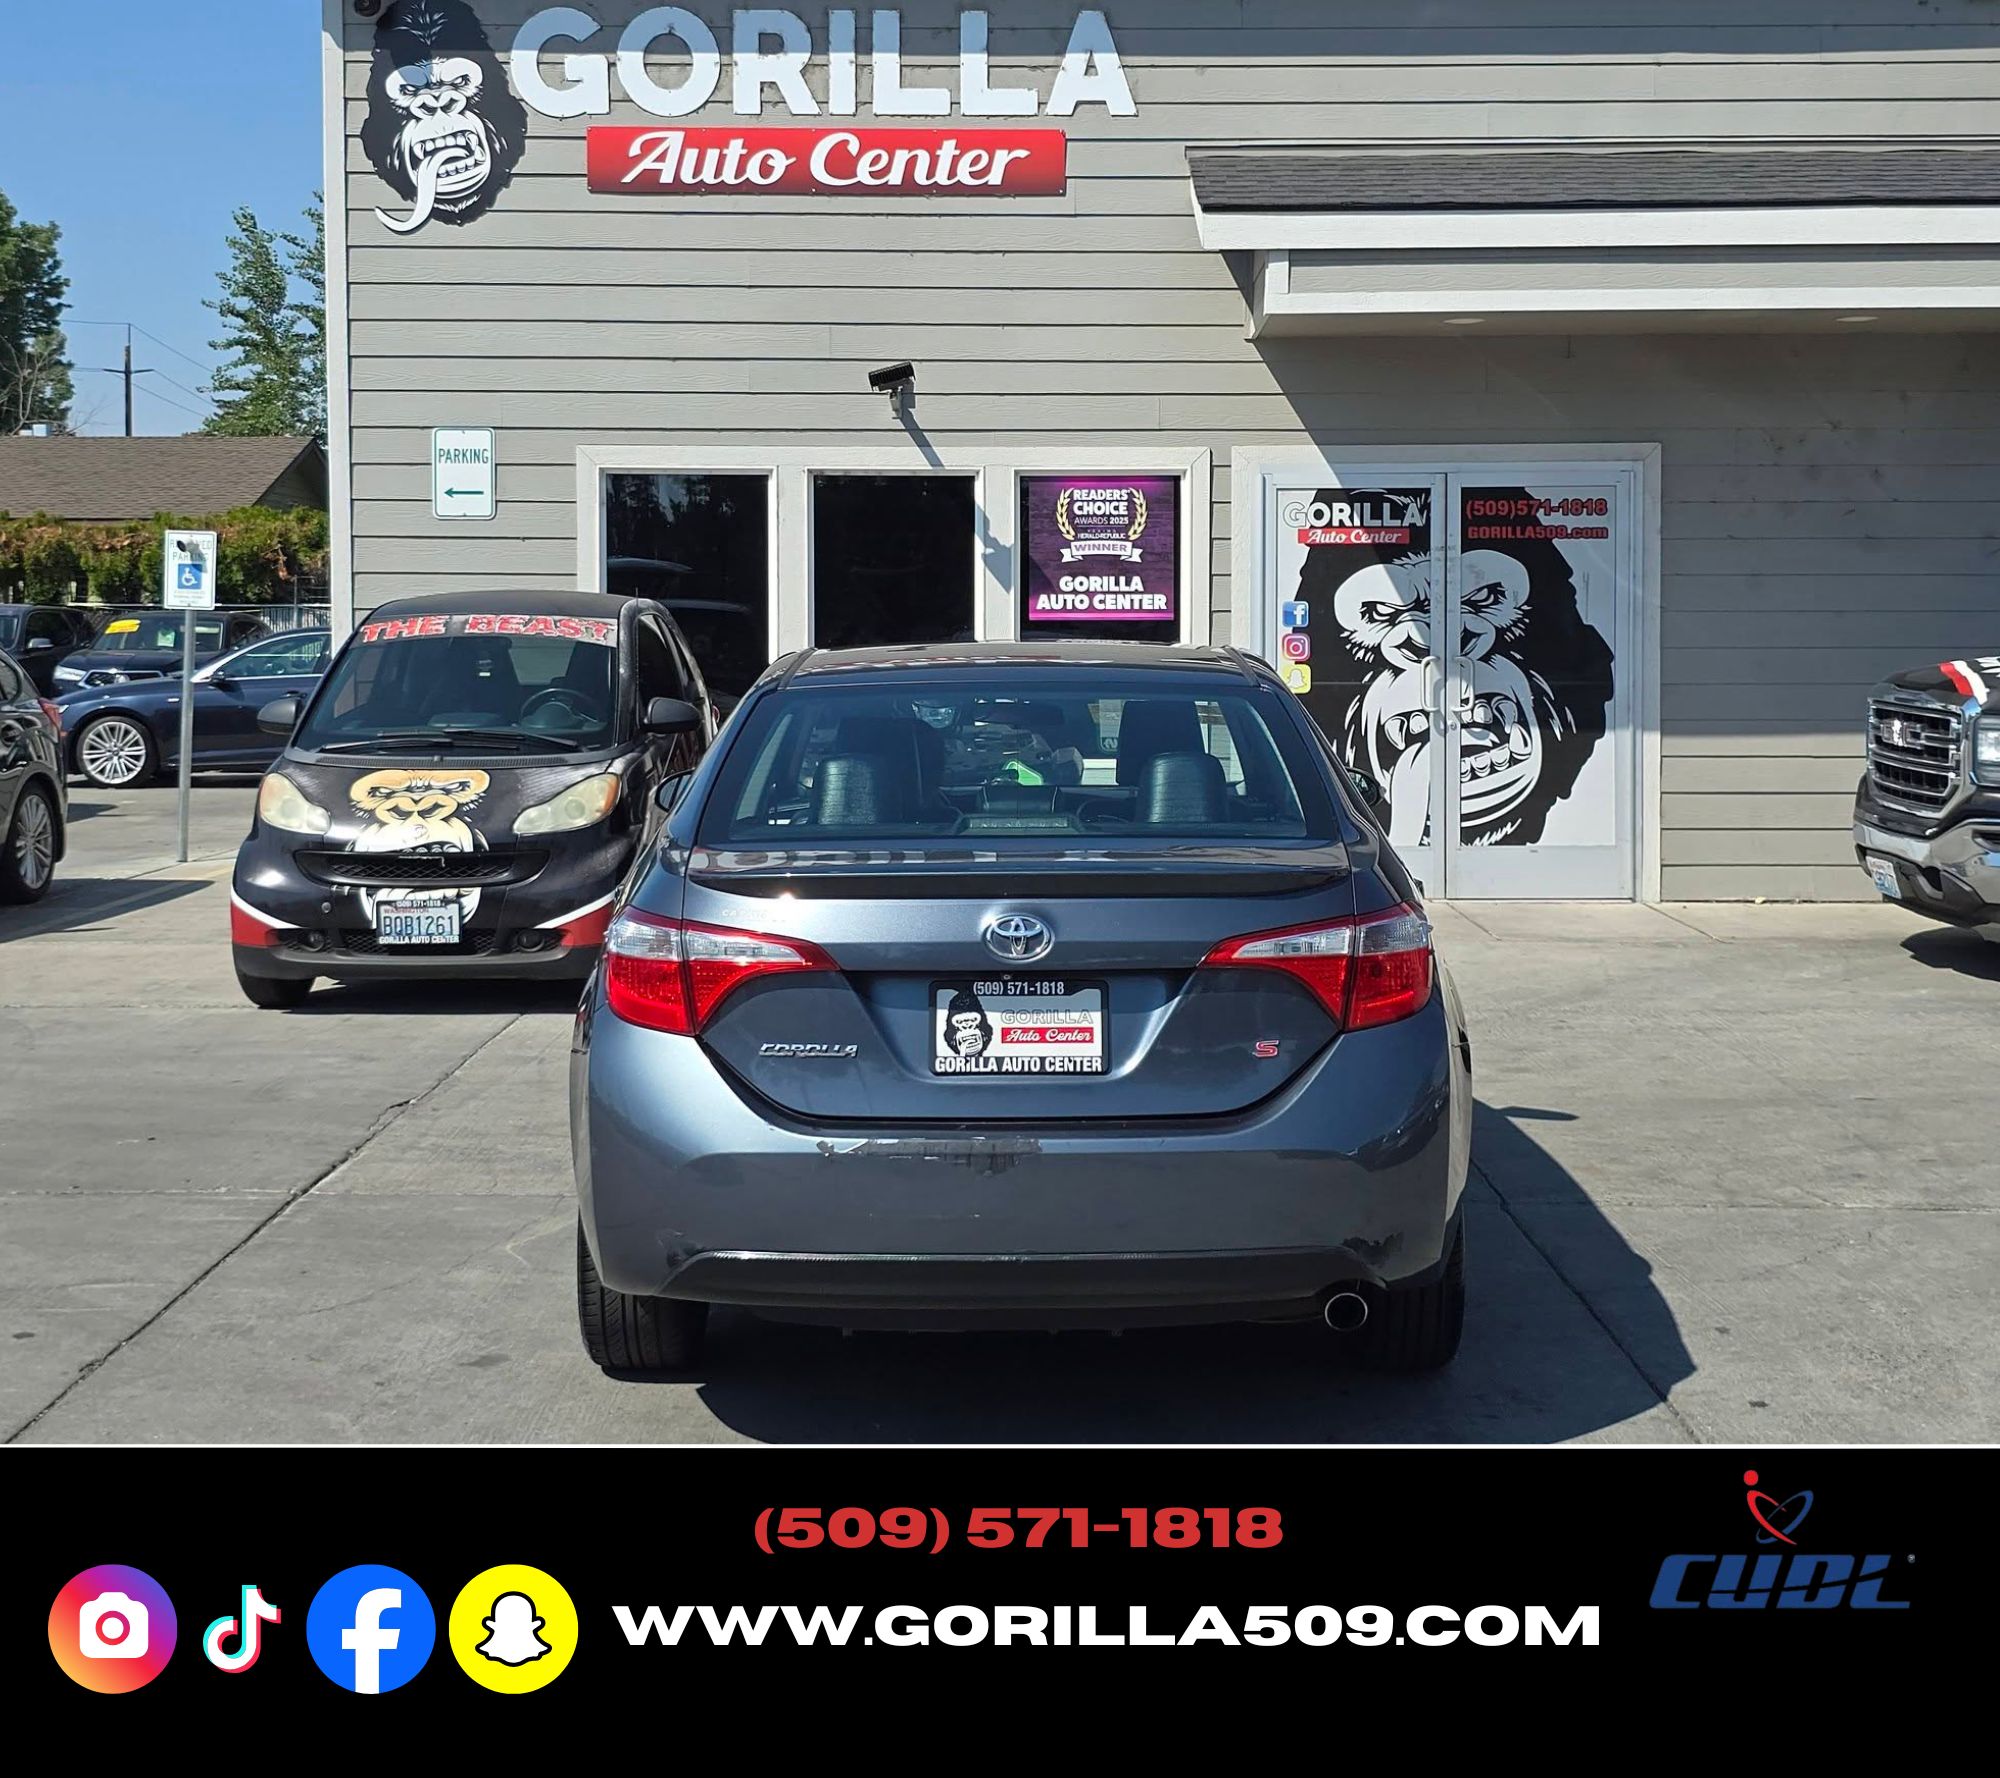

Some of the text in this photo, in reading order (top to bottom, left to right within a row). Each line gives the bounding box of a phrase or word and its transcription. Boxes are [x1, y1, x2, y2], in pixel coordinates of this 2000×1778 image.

[511, 6, 1138, 119] GORILLA
[621, 131, 1031, 187] Auto Center
[438, 448, 489, 464] PARKING
[1073, 501, 1129, 515] CHOICE
[1283, 501, 1425, 528] GORILLA
[1466, 498, 1608, 519] (509)571-1818
[1074, 517, 1129, 525] AWARDS 2025
[1307, 529, 1402, 543] Auto Center
[1467, 525, 1609, 539] GORILLA509.com
[1073, 543, 1128, 552] WINNER
[1059, 575, 1144, 592] GORILLA
[1036, 594, 1168, 610] AUTO CENTER
[360, 613, 618, 643] THE BEAST
[383, 915, 454, 936] BQB1261
[411, 936, 430, 944] AUTO
[973, 982, 1065, 995] (509) 571-1818
[1001, 1009, 1094, 1025] GORILLA
[1006, 1029, 1092, 1042] Auto Center
[759, 1043, 858, 1057] COROLLA
[1252, 1040, 1279, 1057] S
[935, 1056, 1102, 1072] GORILLA AUTO CENTER
